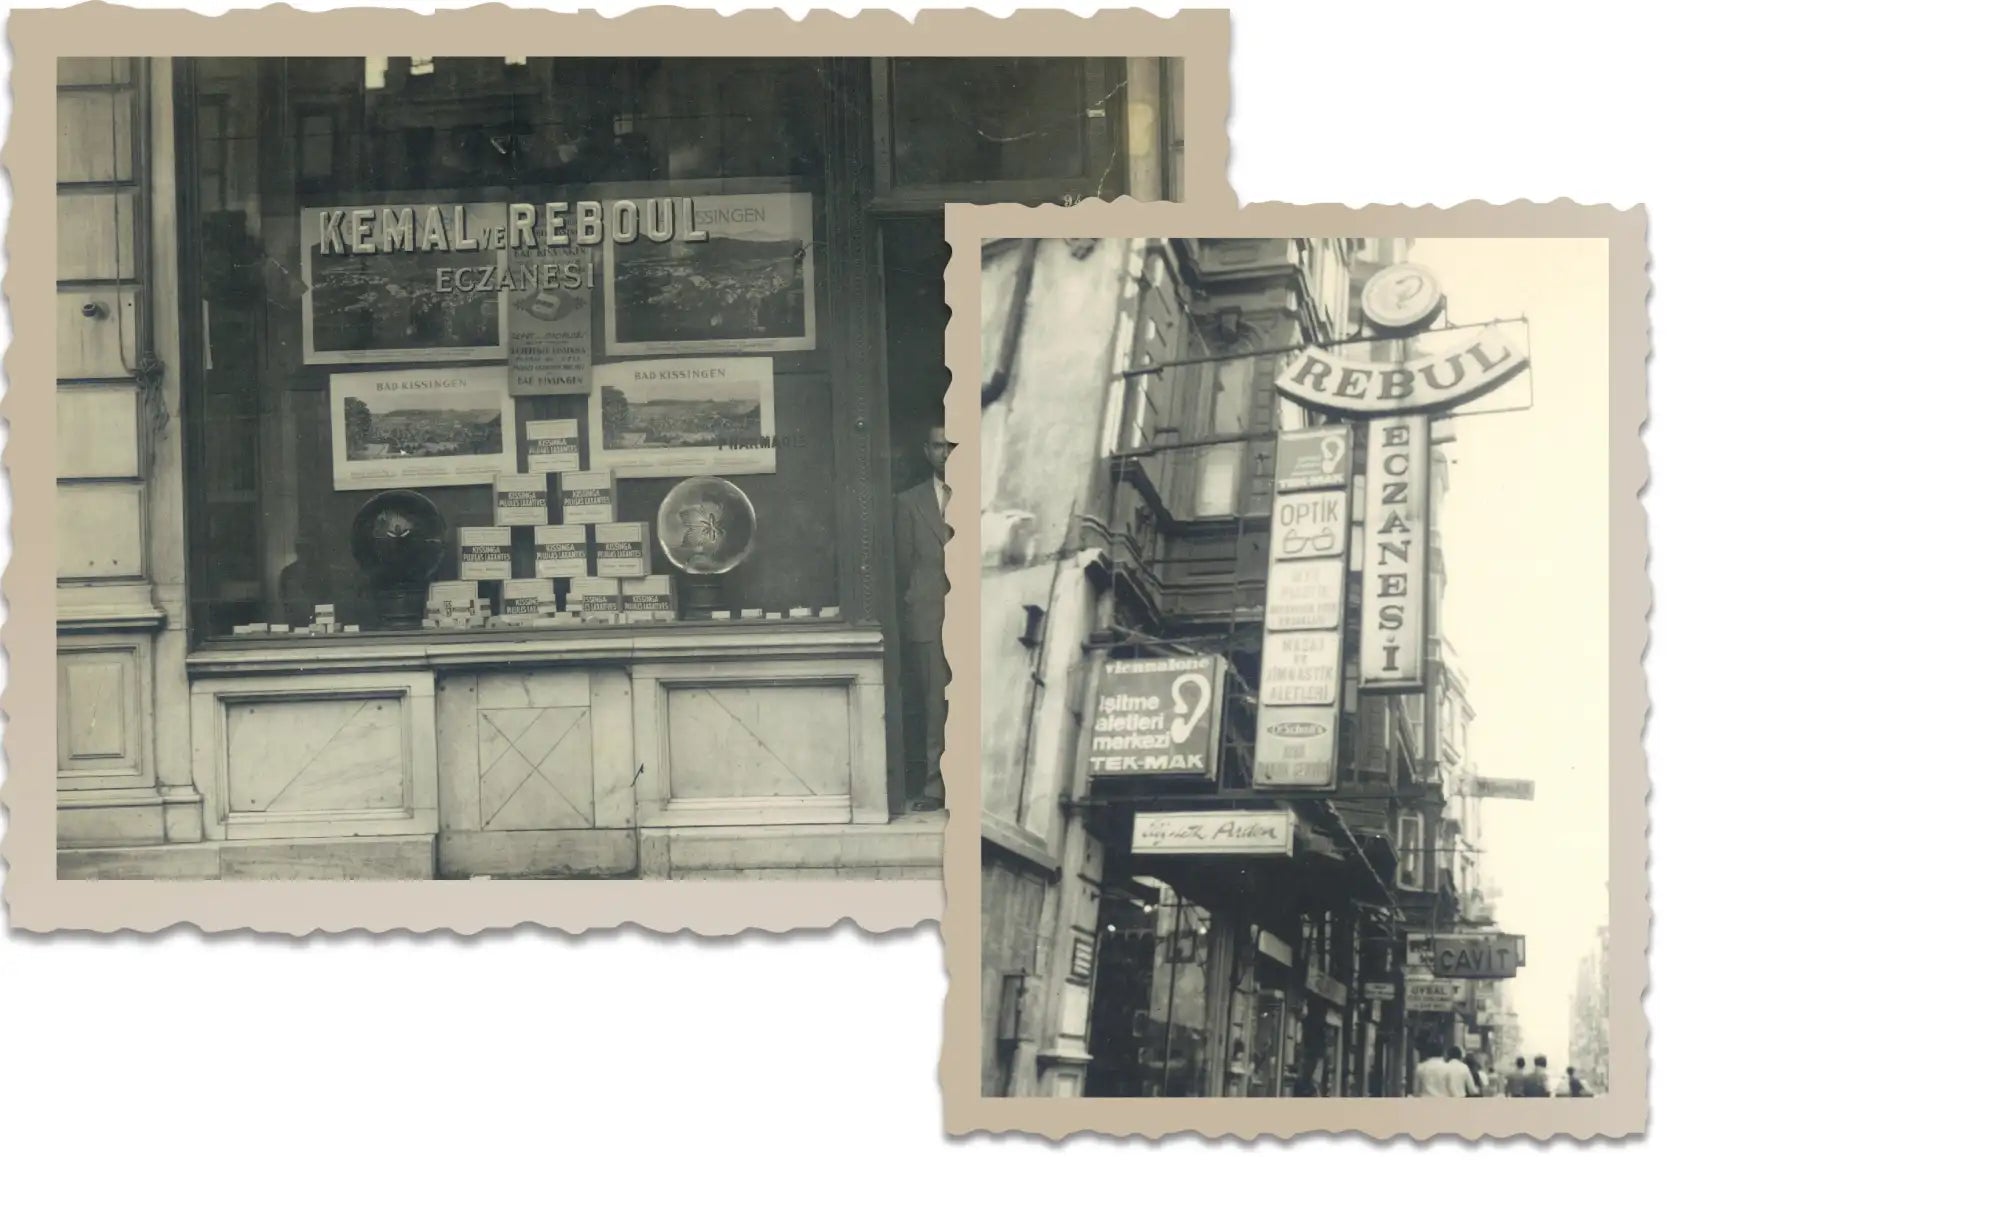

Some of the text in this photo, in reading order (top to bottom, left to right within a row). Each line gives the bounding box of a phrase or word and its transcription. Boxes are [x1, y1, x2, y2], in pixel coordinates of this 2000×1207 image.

[319, 205, 480, 255] KEMAL
[509, 198, 709, 249] REBOUL
[436, 263, 596, 293] ECZANESI
[635, 368, 727, 381] BAD KISSINGEN
[1290, 341, 1512, 401] REBUL
[376, 379, 467, 392] BAD KISSINGEN
[1280, 497, 1339, 526] OPTİK
[546, 543, 575, 552] KISSINGA
[605, 542, 632, 551] KISSINGA
[1377, 424, 1412, 671] ECZANESİ
[515, 598, 538, 606] KISSIN
[584, 596, 607, 604] ISSINGA
[1094, 712, 1165, 732] aletleri
[1092, 731, 1171, 751] merkezi
[1089, 753, 1204, 771] TEK-MAK
[1440, 940, 1510, 971] CAVİT
